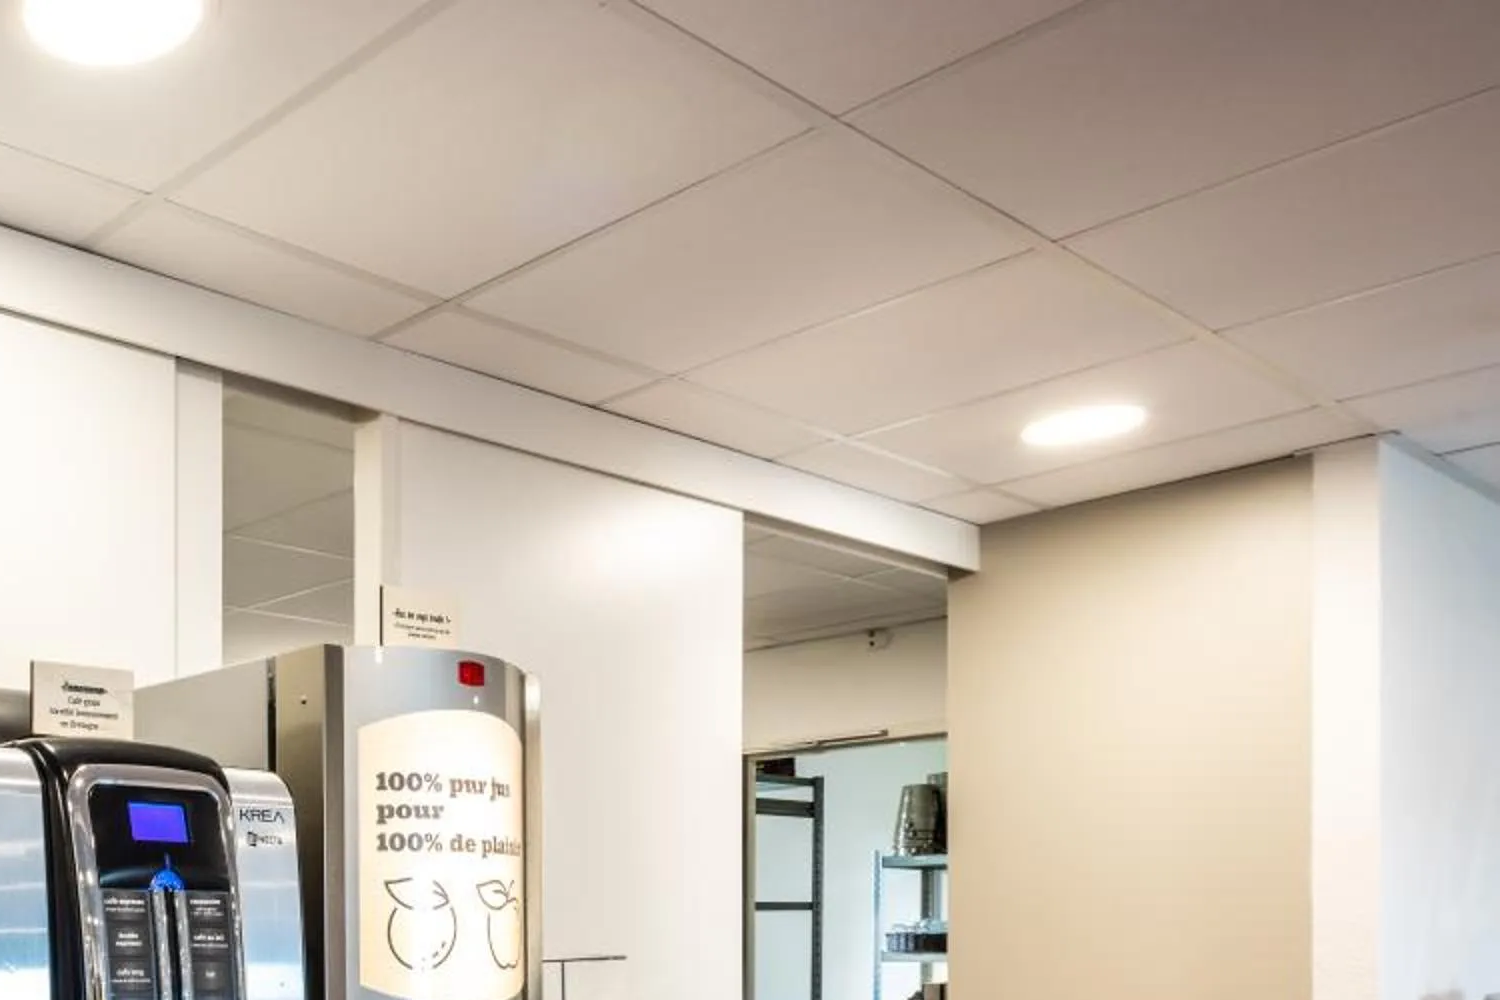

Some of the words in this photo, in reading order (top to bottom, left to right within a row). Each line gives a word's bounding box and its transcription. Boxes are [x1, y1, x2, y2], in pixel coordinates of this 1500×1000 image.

[375, 771, 443, 793] 100%
[449, 778, 488, 799] pur
[375, 803, 445, 825] pour
[376, 832, 443, 852] 100%
[449, 833, 477, 853] de
